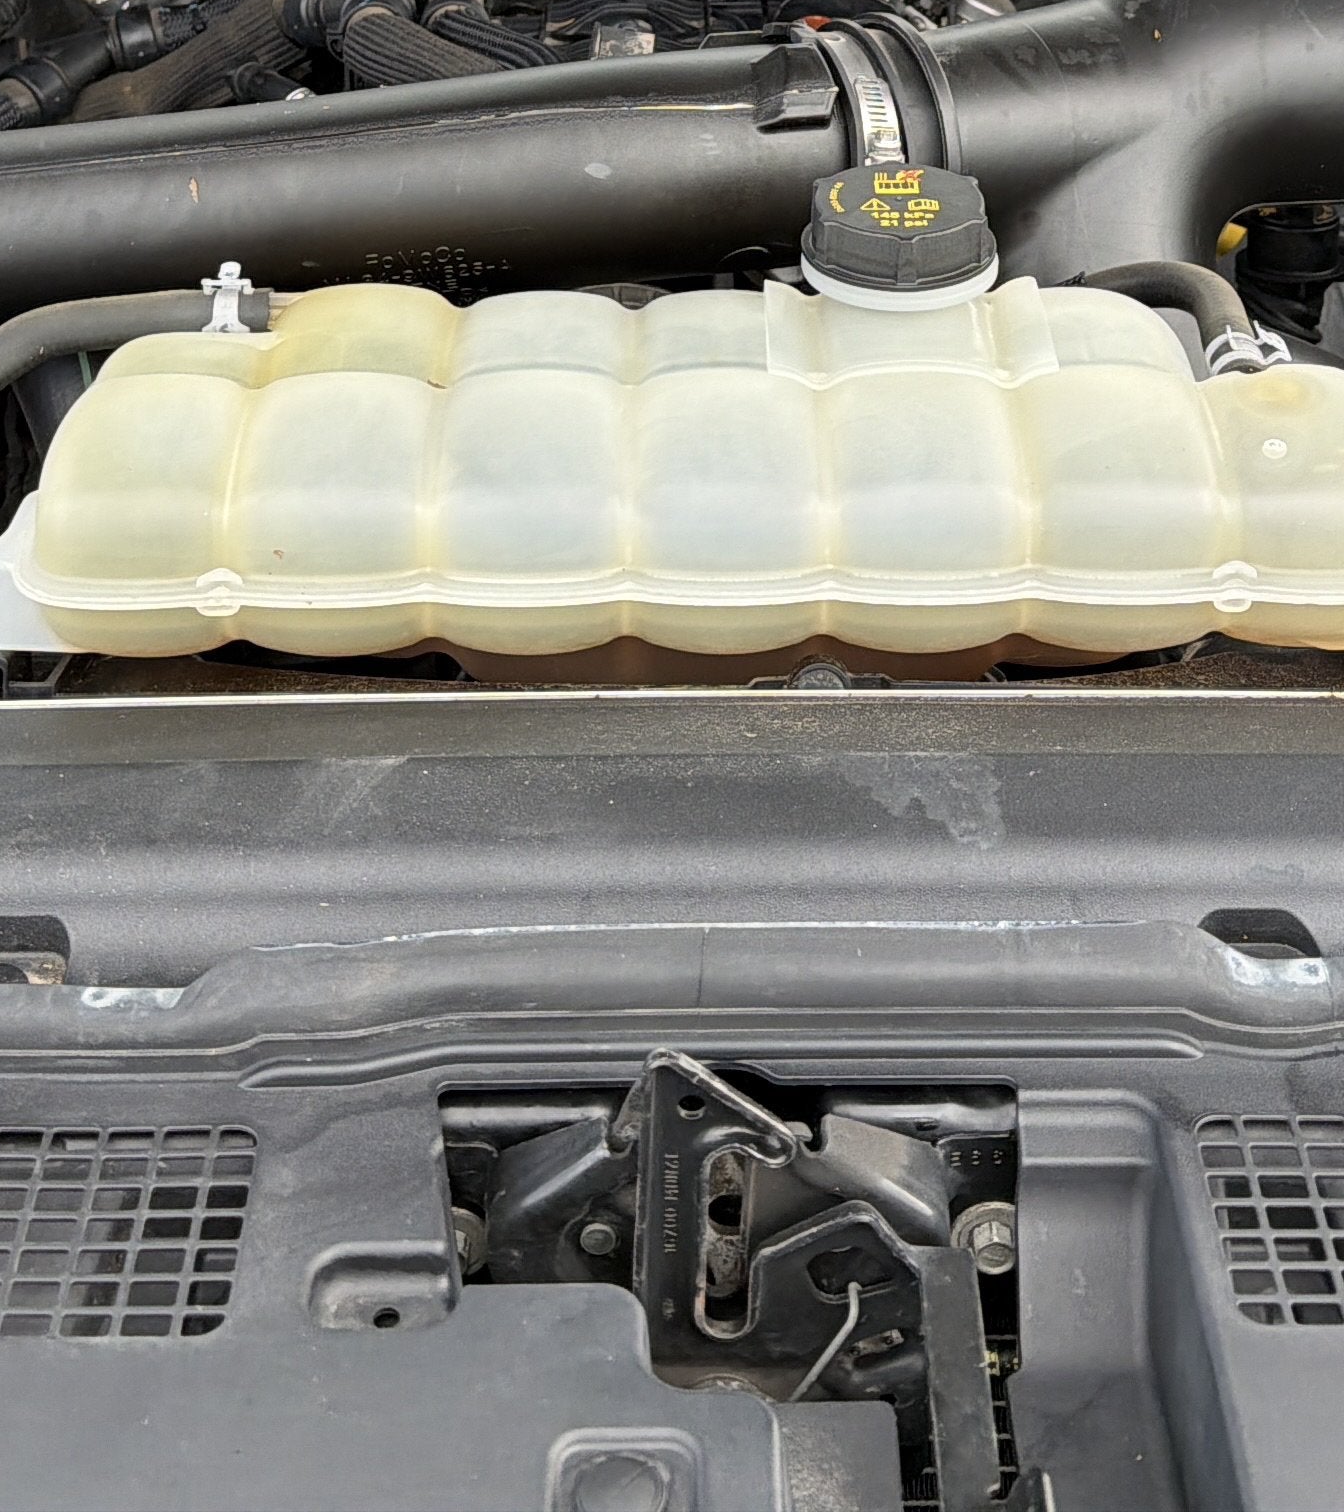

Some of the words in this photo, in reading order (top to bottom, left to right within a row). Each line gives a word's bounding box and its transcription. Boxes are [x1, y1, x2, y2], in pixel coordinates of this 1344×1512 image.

[903, 211, 935, 219] kPa
[879, 219, 899, 227] 21
[903, 219, 929, 228] psi
